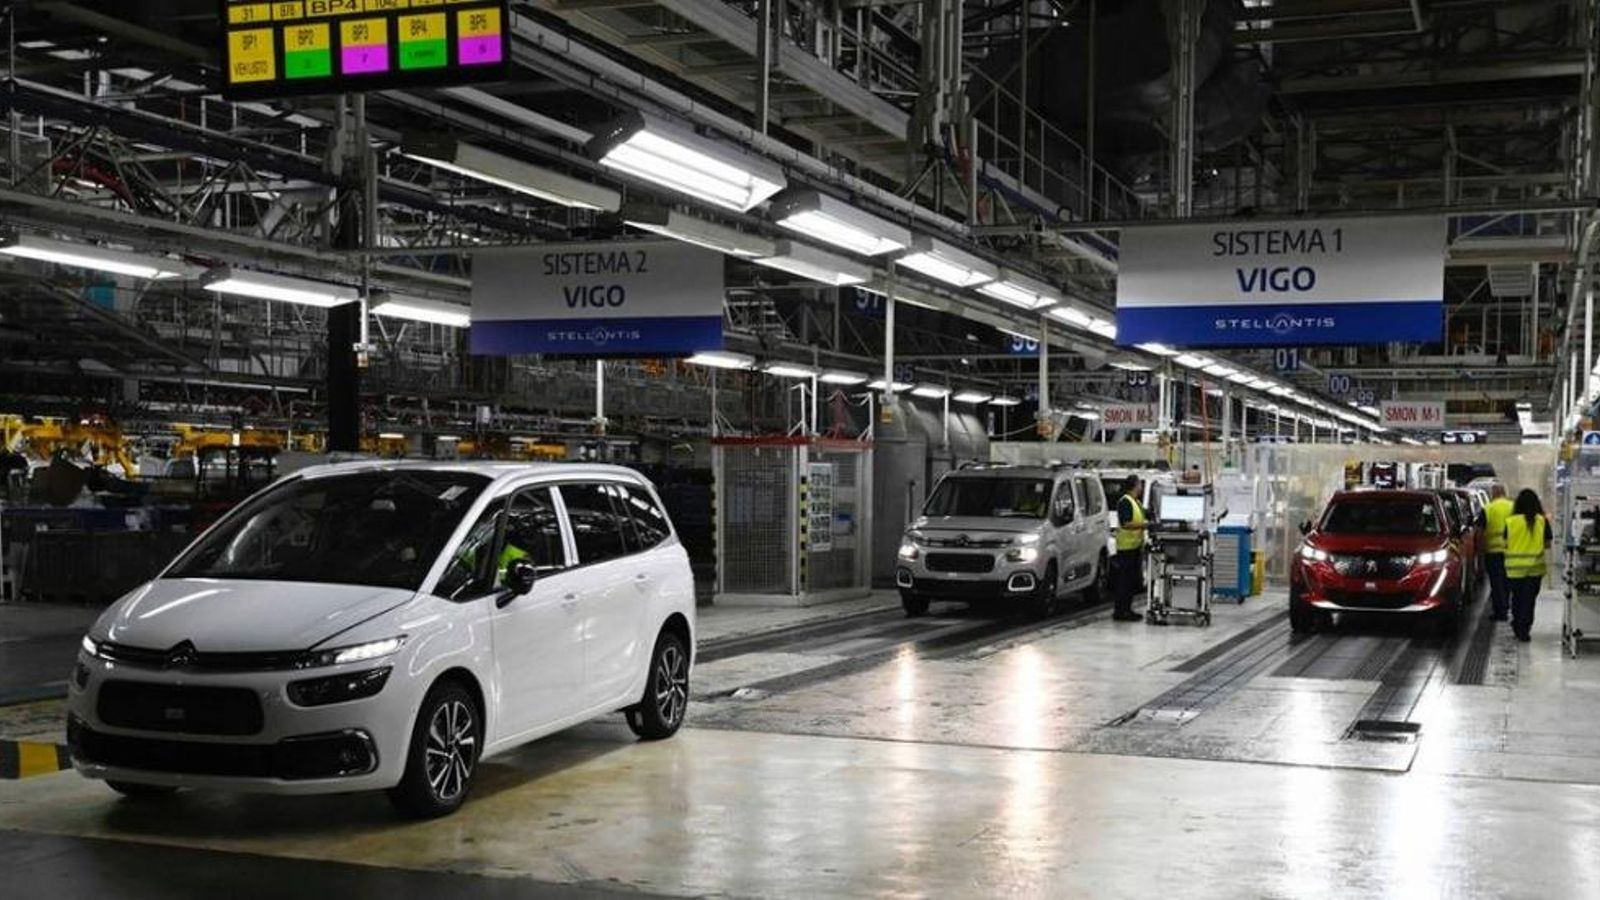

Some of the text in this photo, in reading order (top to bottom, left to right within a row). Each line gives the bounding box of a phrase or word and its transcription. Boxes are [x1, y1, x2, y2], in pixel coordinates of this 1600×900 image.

[311, 0, 357, 14] BP4
[1212, 229, 1343, 256] SISTEMA 1
[543, 250, 648, 275] SISTEMA 2
[1237, 266, 1316, 292] VIGO
[563, 285, 626, 308] VIGO
[1214, 316, 1336, 329] STELLANTIS
[547, 330, 641, 342] STELLANTIS
[1275, 349, 1298, 369] 01
[1330, 377, 1349, 393] 00
